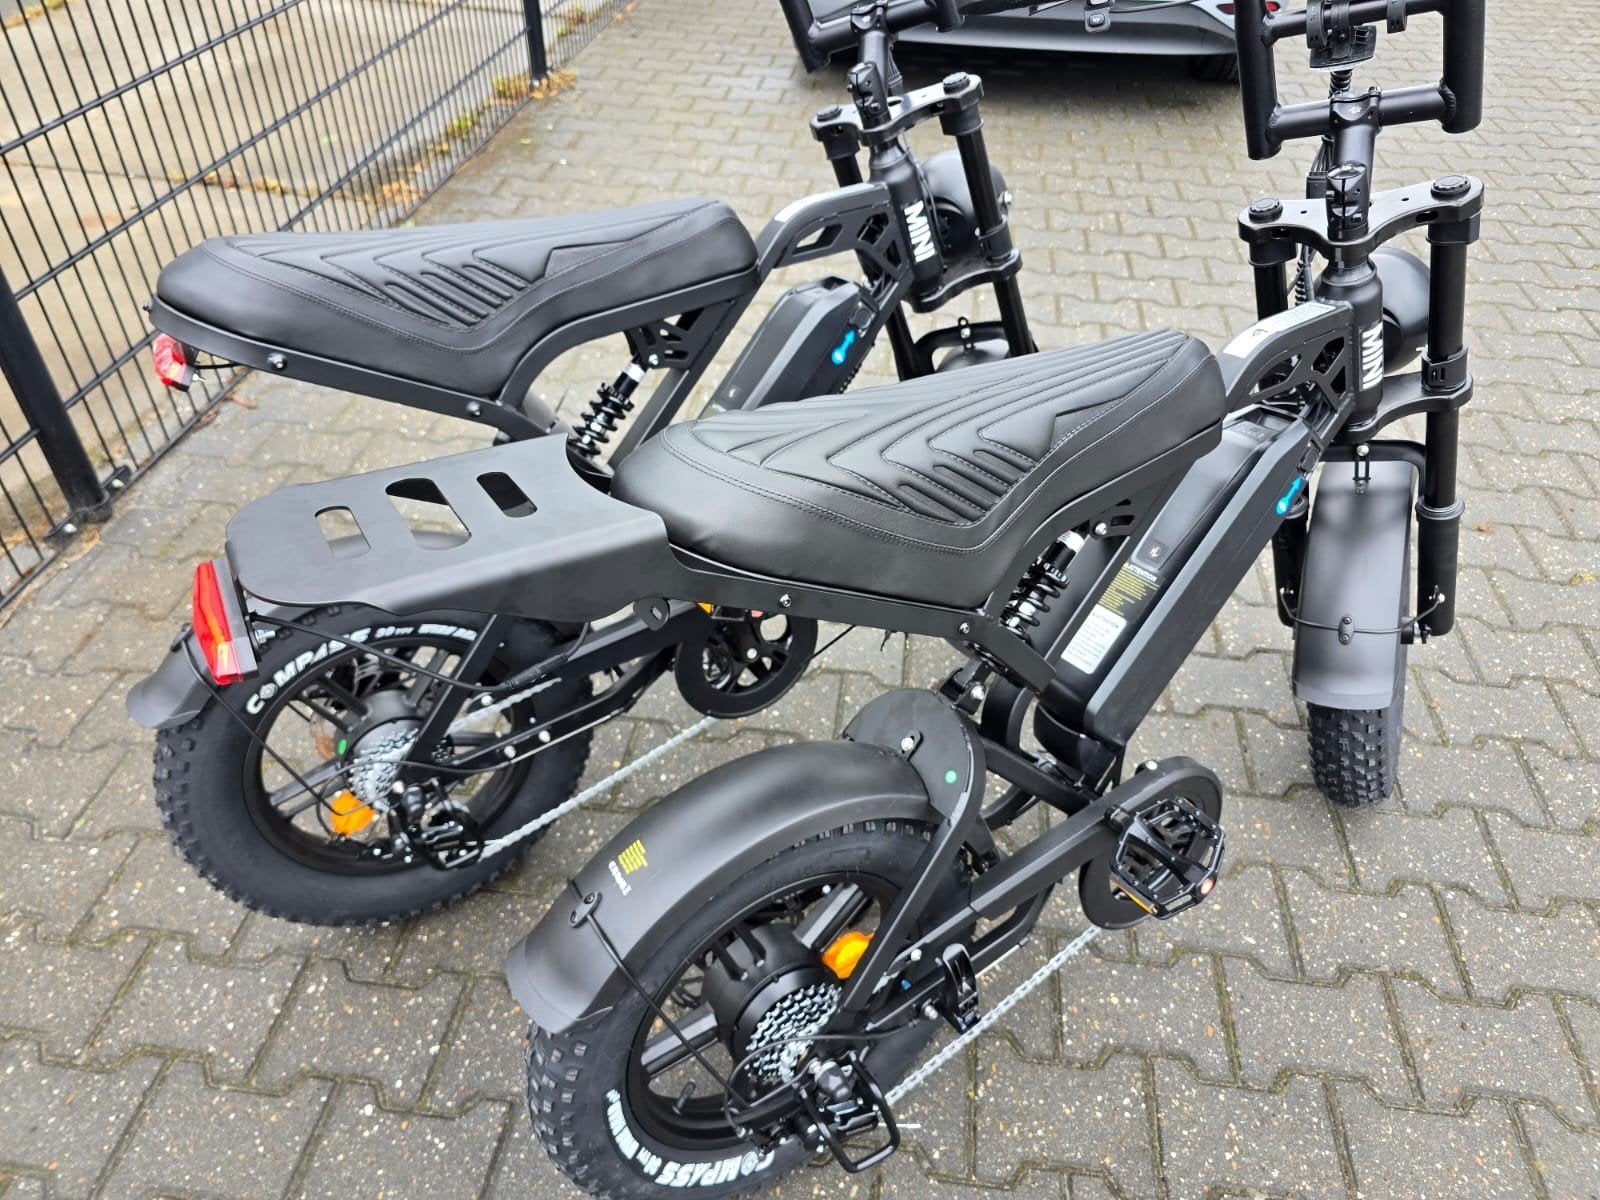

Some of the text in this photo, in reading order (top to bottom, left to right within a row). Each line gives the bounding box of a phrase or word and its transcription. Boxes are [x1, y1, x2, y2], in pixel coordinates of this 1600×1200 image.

[904, 200, 935, 262] MINI
[1362, 322, 1384, 389] MINI
[654, 1149, 775, 1188] COMPASS
